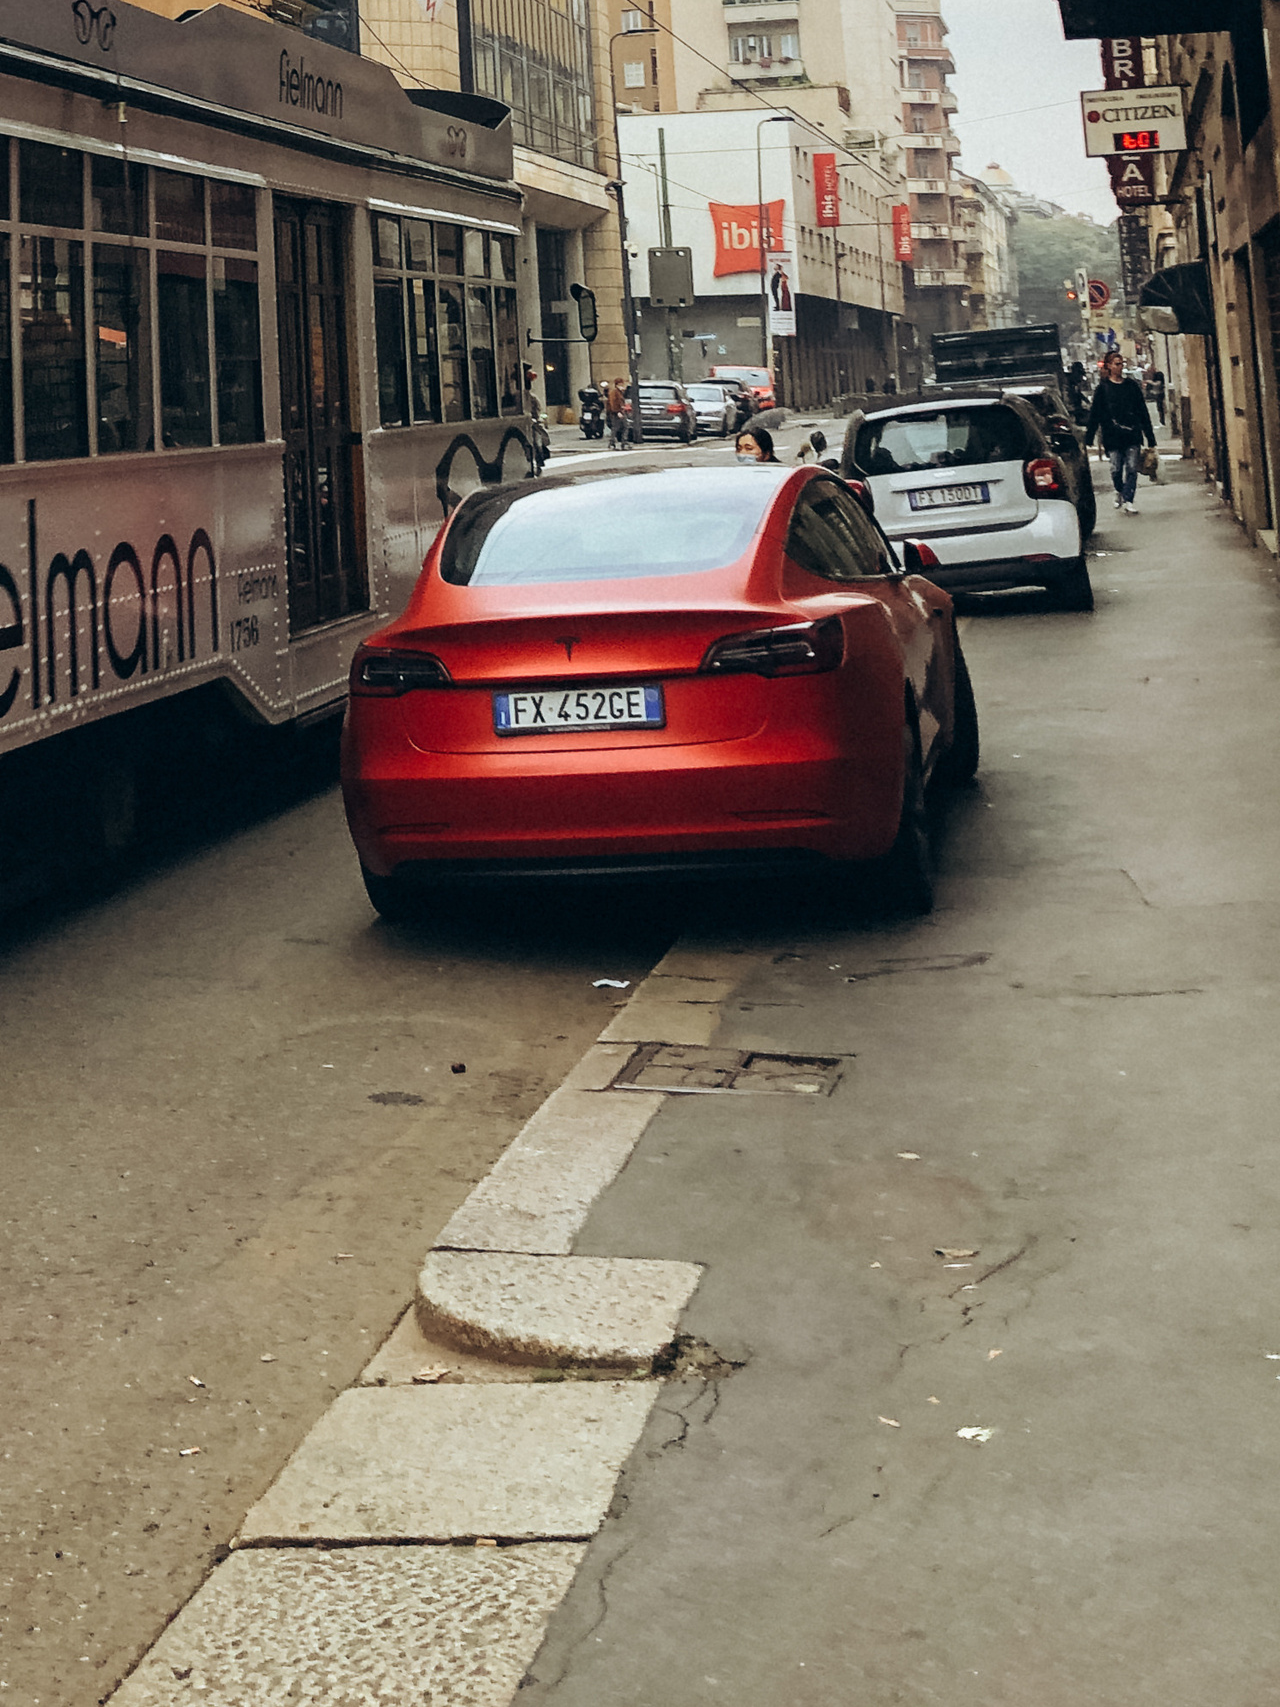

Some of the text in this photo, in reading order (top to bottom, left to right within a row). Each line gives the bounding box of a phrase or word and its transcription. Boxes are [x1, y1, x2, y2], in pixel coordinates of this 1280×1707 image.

[279, 48, 343, 120] fielmann
[1102, 104, 1178, 123] CITIZEN
[821, 163, 837, 218] ibis HOTEL
[721, 220, 776, 250] ibis
[898, 236, 911, 254] ibis
[513, 695, 546, 725] FX
[557, 690, 643, 722] 452GE
